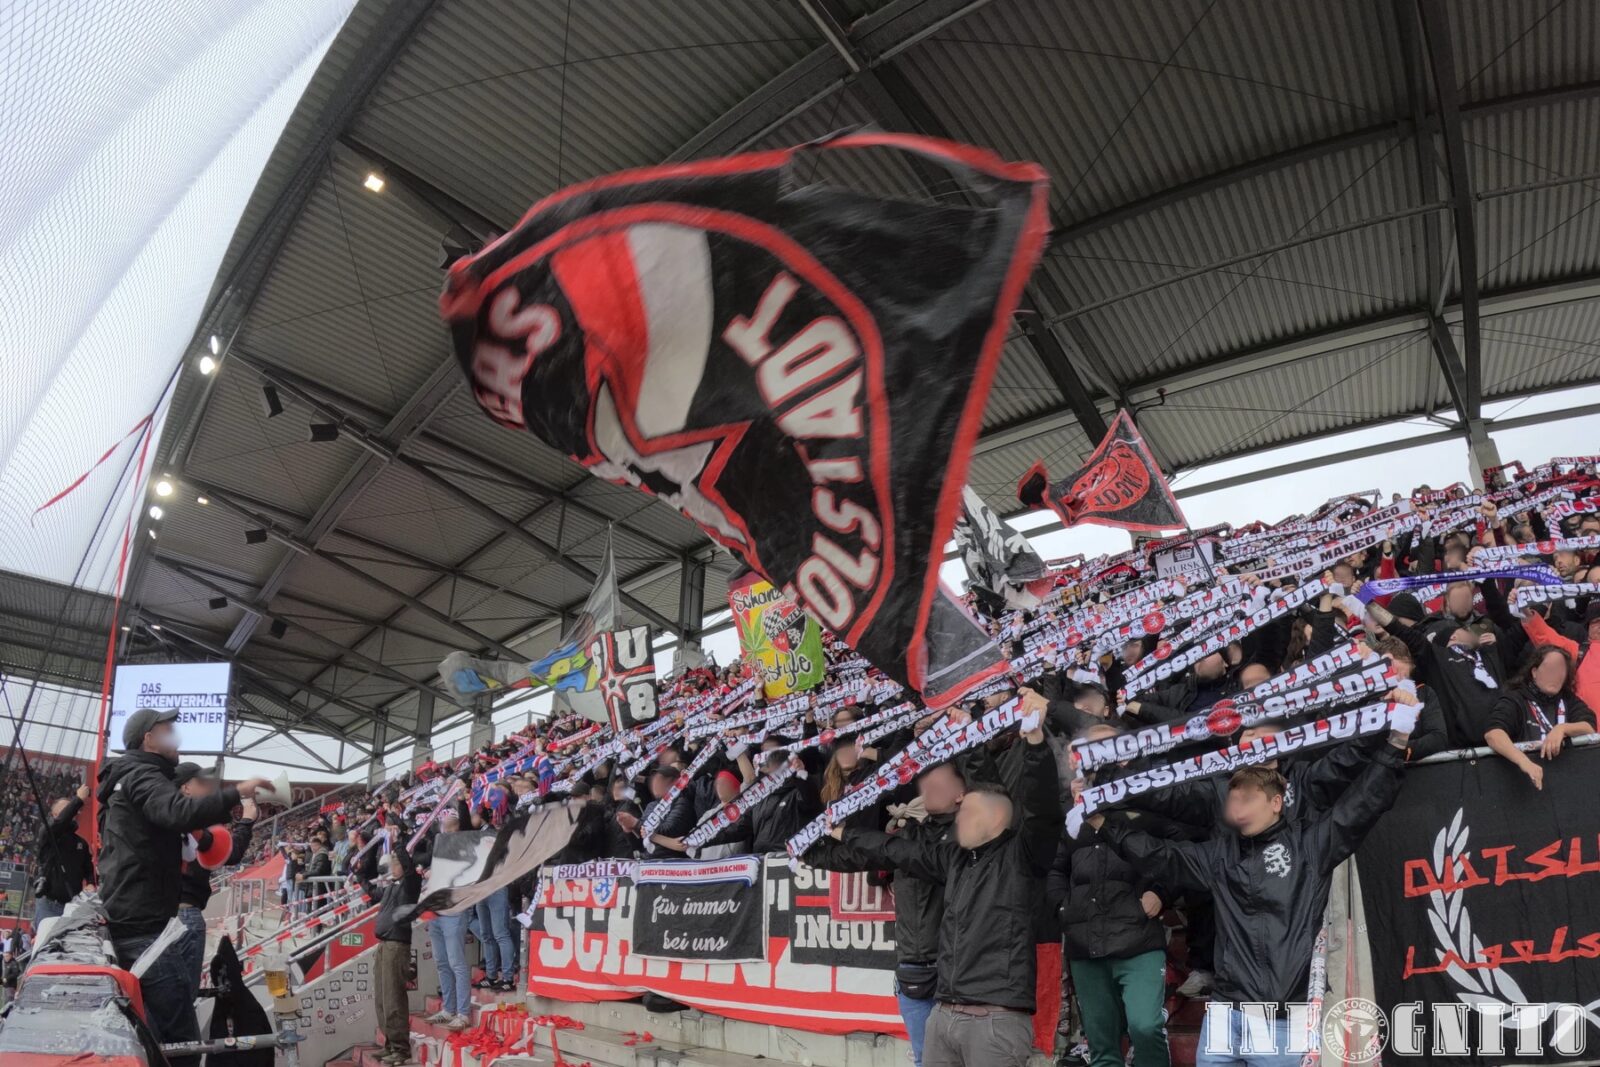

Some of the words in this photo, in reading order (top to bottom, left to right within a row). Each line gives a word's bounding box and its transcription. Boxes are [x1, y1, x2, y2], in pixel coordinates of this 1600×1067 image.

[1351, 505, 1400, 531] MANEO
[1320, 535, 1376, 562] MANEO
[141, 683, 162, 693] DAS
[1264, 664, 1389, 718] STADT
[930, 696, 1021, 761] STADT
[1081, 703, 1388, 815] FUSSBALLCLUB
[651, 895, 680, 923] für
[682, 897, 741, 915] immer
[662, 930, 690, 950] bei
[692, 936, 729, 952] uns
[794, 914, 898, 951] INGOL
